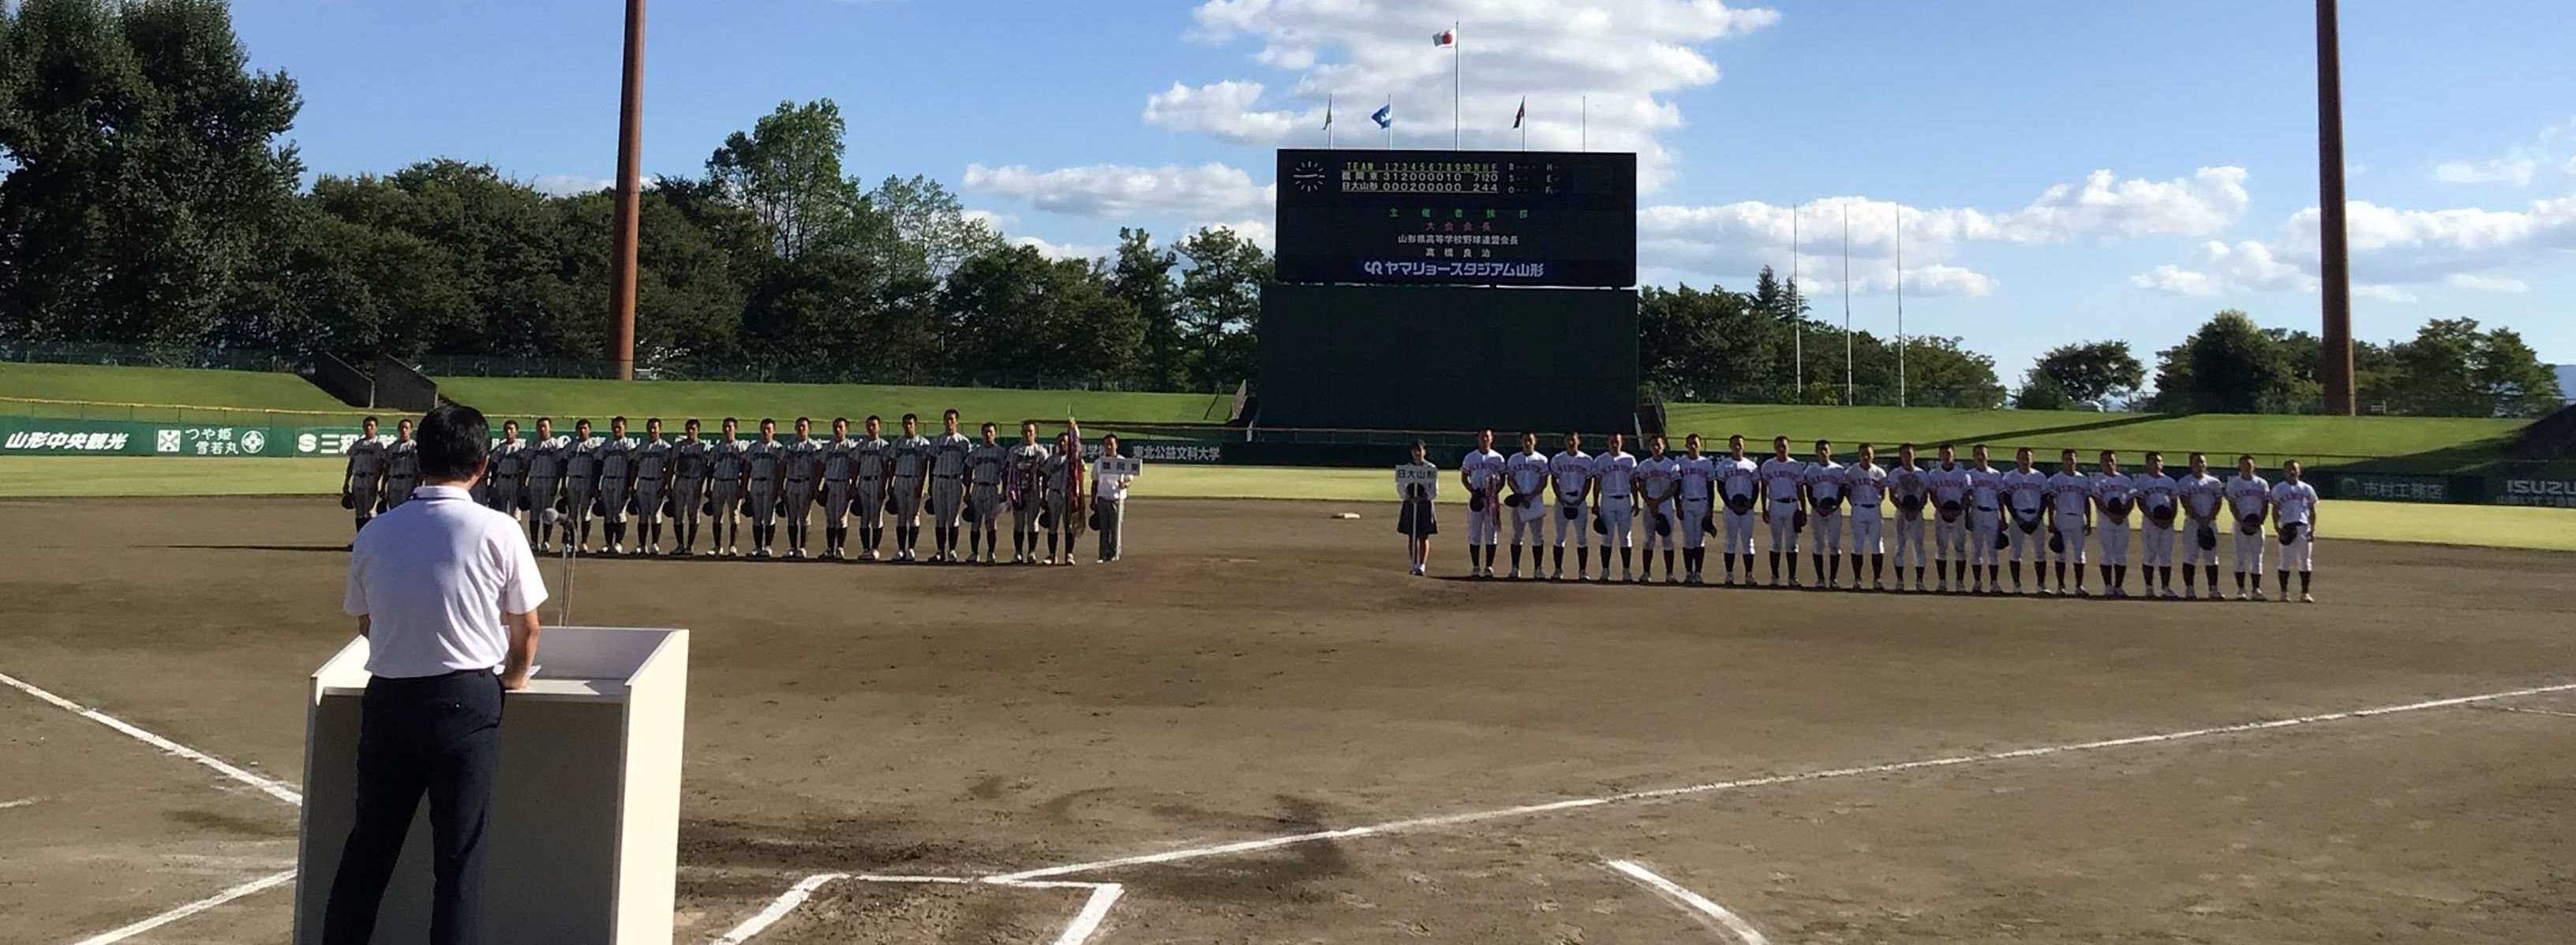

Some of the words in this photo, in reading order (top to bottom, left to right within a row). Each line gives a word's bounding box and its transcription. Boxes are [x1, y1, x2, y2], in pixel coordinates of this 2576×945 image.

[1342, 182, 1378, 191] 日大山形
[1385, 261, 1544, 277] ヤマリョースタジアム山形
[5, 431, 129, 450] 山形中央観光
[185, 428, 232, 441] つや姫
[1133, 446, 1221, 460] 東北公益文科大学
[2507, 480, 2576, 495] ISUZU
